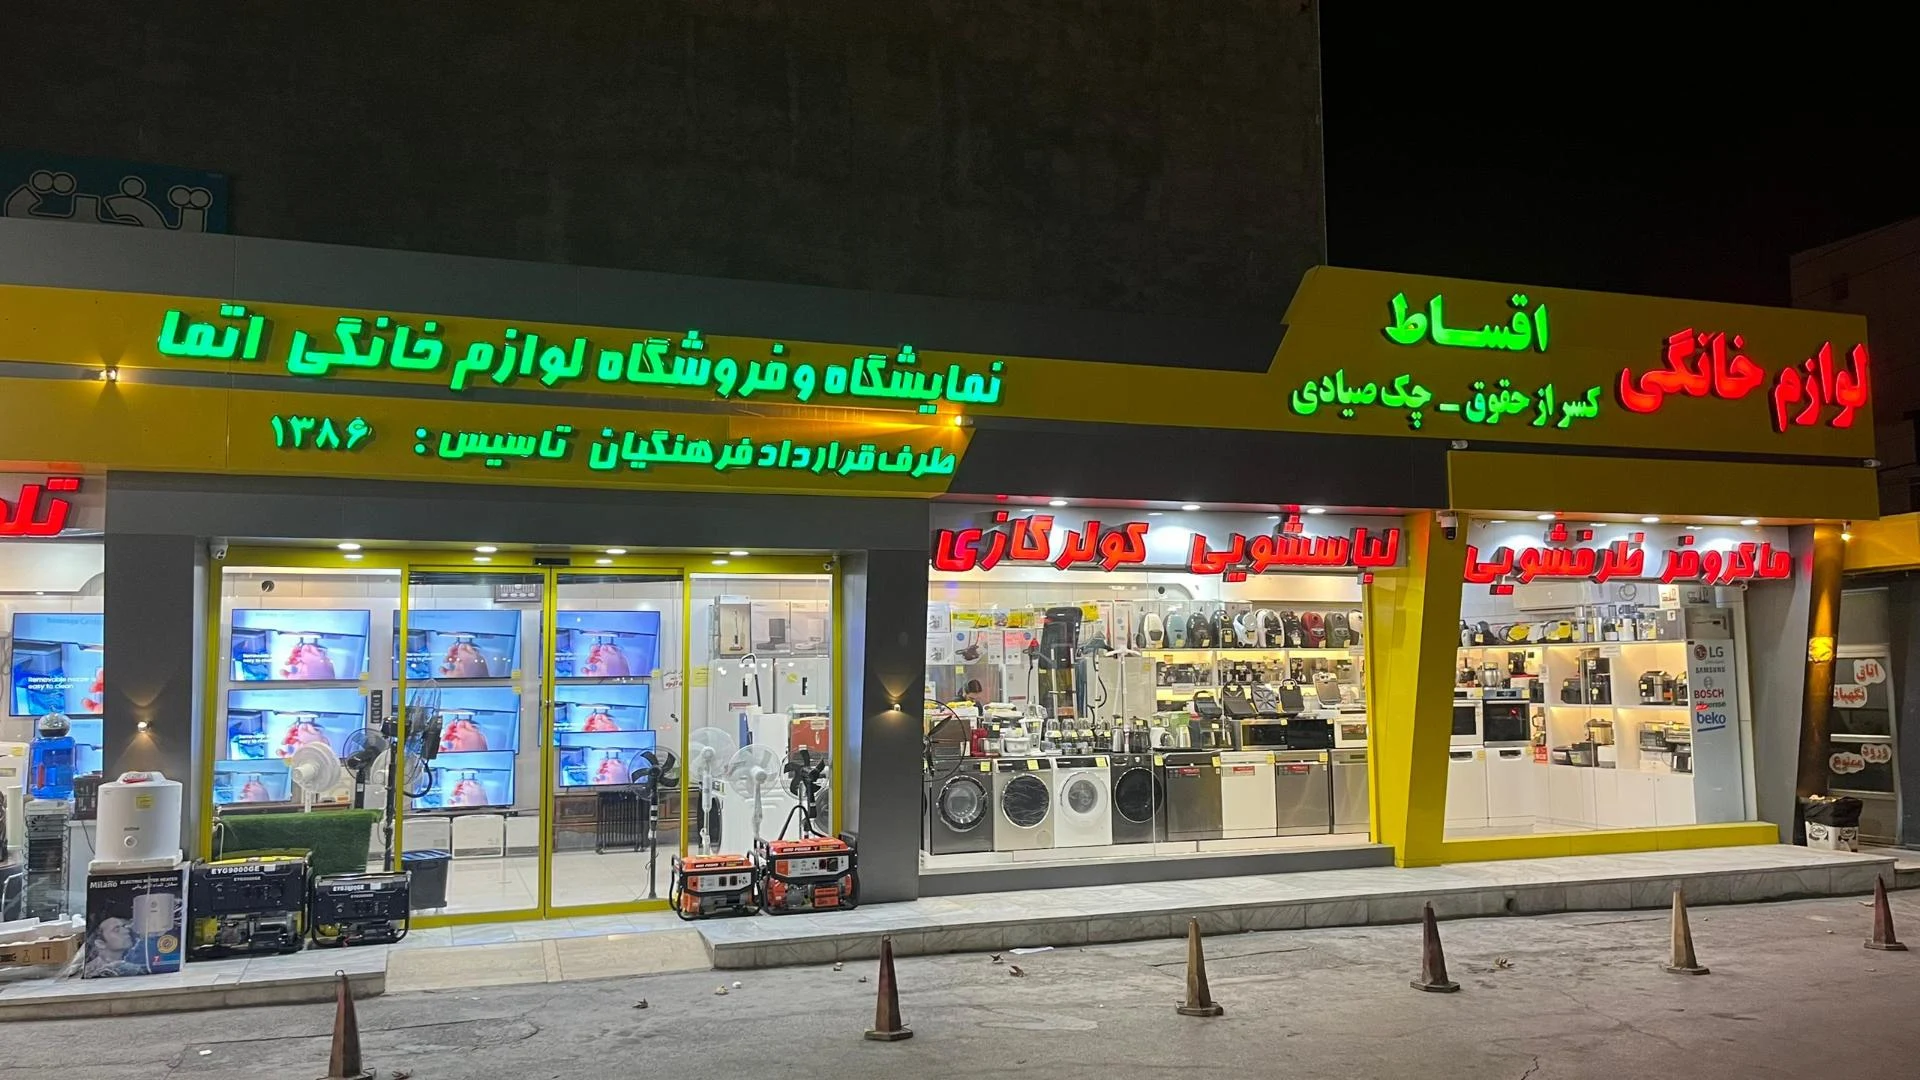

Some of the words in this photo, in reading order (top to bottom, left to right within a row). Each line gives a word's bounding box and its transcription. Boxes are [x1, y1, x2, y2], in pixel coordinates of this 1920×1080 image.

[156, 303, 266, 360] اتما
[285, 315, 445, 377] خانگی
[1384, 292, 1550, 353] اقساط
[448, 327, 588, 391] لوازم
[596, 329, 789, 399] فروشگاه
[792, 362, 817, 402] و
[822, 344, 1005, 416] نمایشگاه
[1619, 327, 1765, 414] خانگی
[1291, 368, 1378, 418] صیادی
[1380, 373, 1433, 430] چک
[1465, 378, 1531, 424] حقوق
[1533, 382, 1555, 427] از
[1558, 384, 1602, 429] کسر
[1774, 341, 1871, 433] لوازم
[270, 415, 370, 450] ۱۳۸۶
[588, 426, 754, 471] فرهنگیان
[757, 439, 877, 476] قرارداد
[877, 441, 957, 478] طرف
[0, 477, 80, 537] تل
[934, 511, 1054, 573] گازی
[1055, 520, 1150, 571] کولر
[1189, 514, 1400, 584] لباسشویی
[1462, 523, 1646, 597] ظرفشویی
[1709, 646, 1724, 658] LG
[1694, 688, 1725, 699] BOSCH
[1696, 711, 1727, 725] beko
